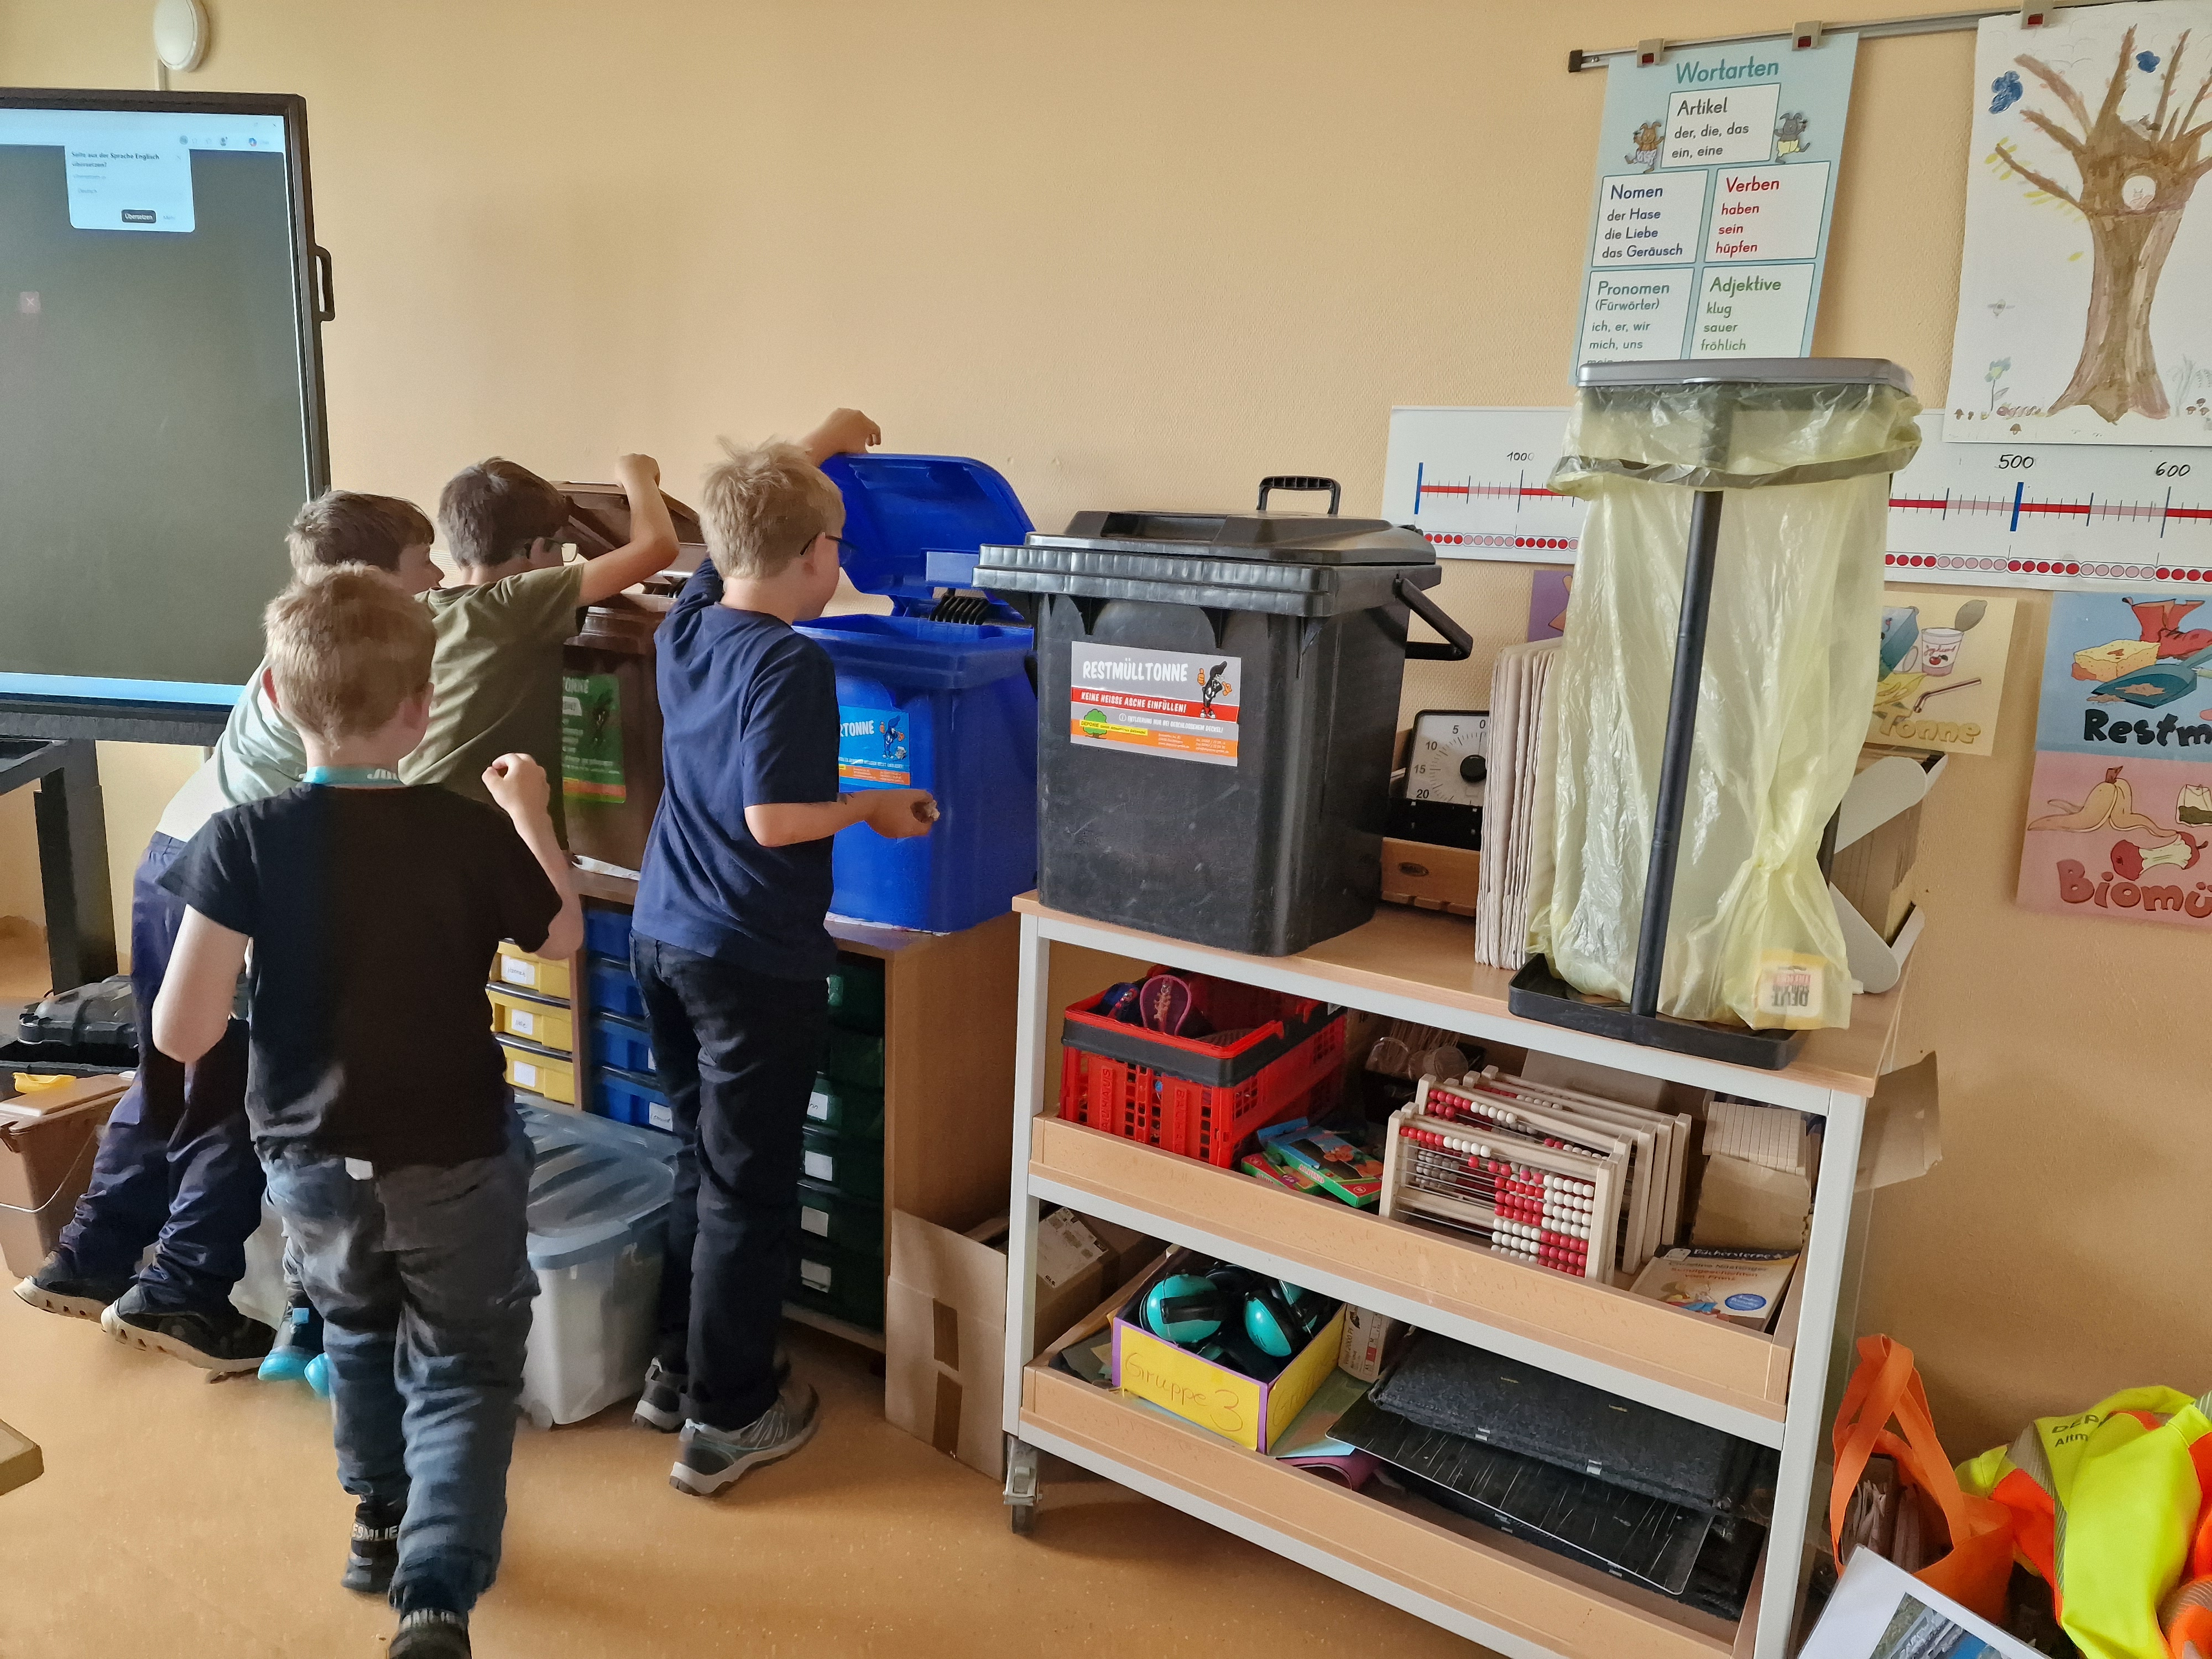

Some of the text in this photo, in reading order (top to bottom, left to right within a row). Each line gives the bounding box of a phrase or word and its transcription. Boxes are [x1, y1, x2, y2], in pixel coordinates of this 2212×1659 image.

[1676, 55, 1779, 84] Wortarten
[1677, 96, 1728, 117] Artikel
[1674, 122, 1749, 139] der, die, das
[1672, 146, 1723, 159] ein, eine
[1726, 175, 1780, 192] Verben
[1610, 184, 1663, 200] Nomen
[1607, 207, 1661, 221] der Hase
[1721, 202, 1760, 215] haben
[1604, 226, 1658, 240] die Liebe
[1718, 223, 1744, 234] sein
[1602, 242, 1683, 258] das Geräusch
[1715, 240, 1758, 258] hüpfen
[1598, 280, 1670, 296] Pronomen
[1709, 275, 1782, 298] Adjektive
[1595, 298, 1660, 311] (Fürwörter)
[1707, 301, 1732, 319] klug
[1592, 320, 1651, 332] ich, er, wir
[1589, 337, 1619, 351] mich,
[1701, 338, 1746, 351] fröhlich
[1506, 451, 1535, 462] 1000
[1998, 454, 2034, 469] 500
[2155, 461, 2191, 478] 600
[1081, 691, 1187, 713] KEINE HEISSE ASCHE EINFÜLLEN!
[1452, 725, 1459, 734] 5
[1479, 719, 1486, 729] 0
[1873, 702, 1981, 744] Tonne
[1426, 741, 1438, 750] 10
[1414, 764, 1426, 774] 15
[1416, 789, 1430, 799] 20
[1125, 1353, 1207, 1406] Gruppe
[1210, 1389, 1243, 1432] 3
